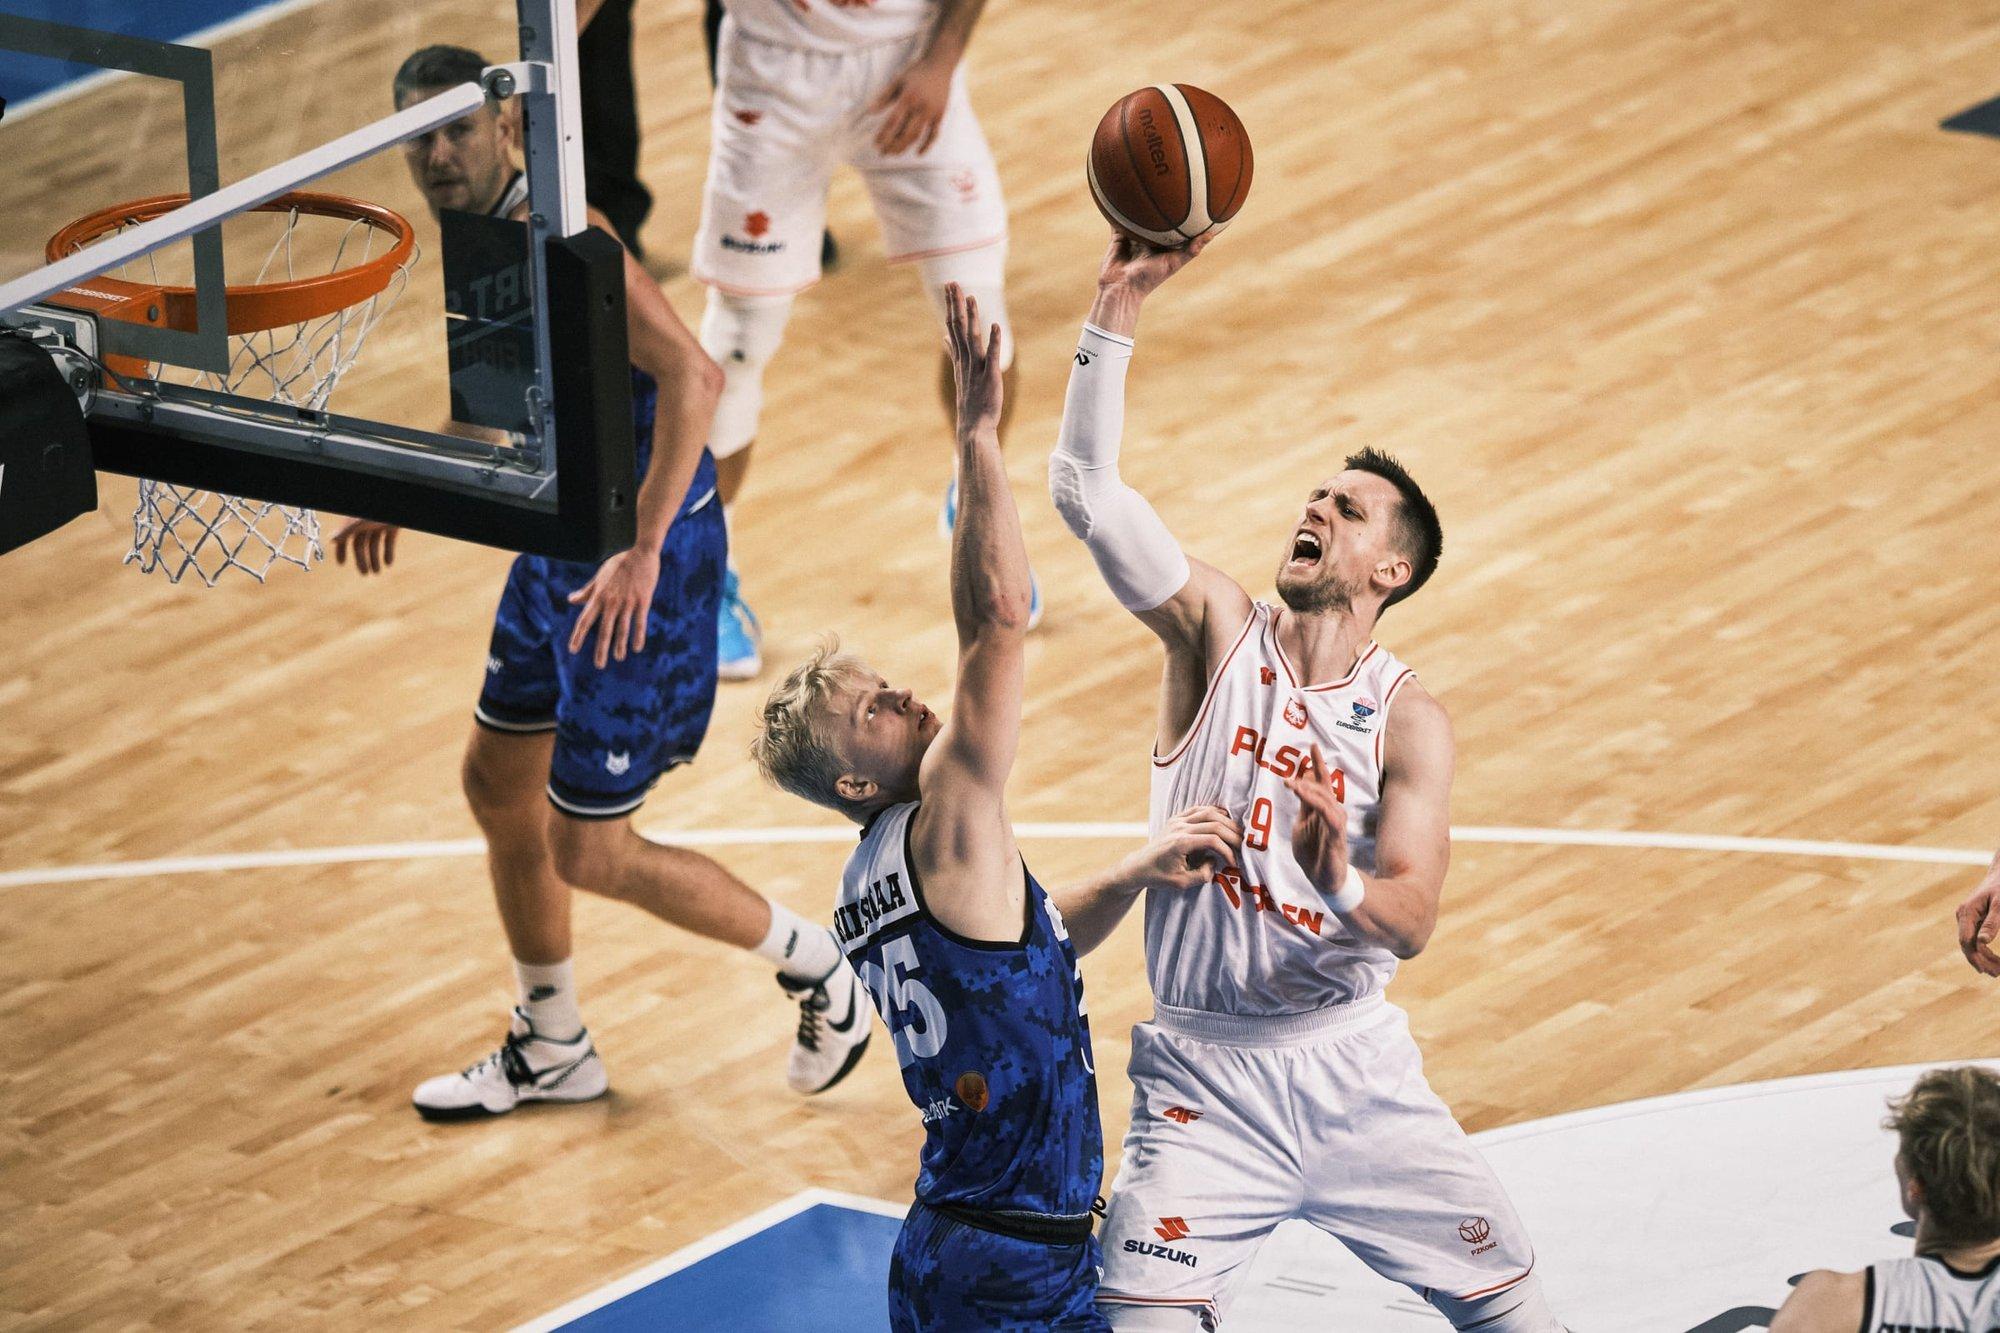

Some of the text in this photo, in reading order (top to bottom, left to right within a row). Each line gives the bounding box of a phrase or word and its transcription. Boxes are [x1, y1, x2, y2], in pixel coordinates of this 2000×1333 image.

[1140, 108, 1170, 177] molten
[1246, 797, 1272, 852] 9
[1123, 1239, 1198, 1268] SUZUKI
